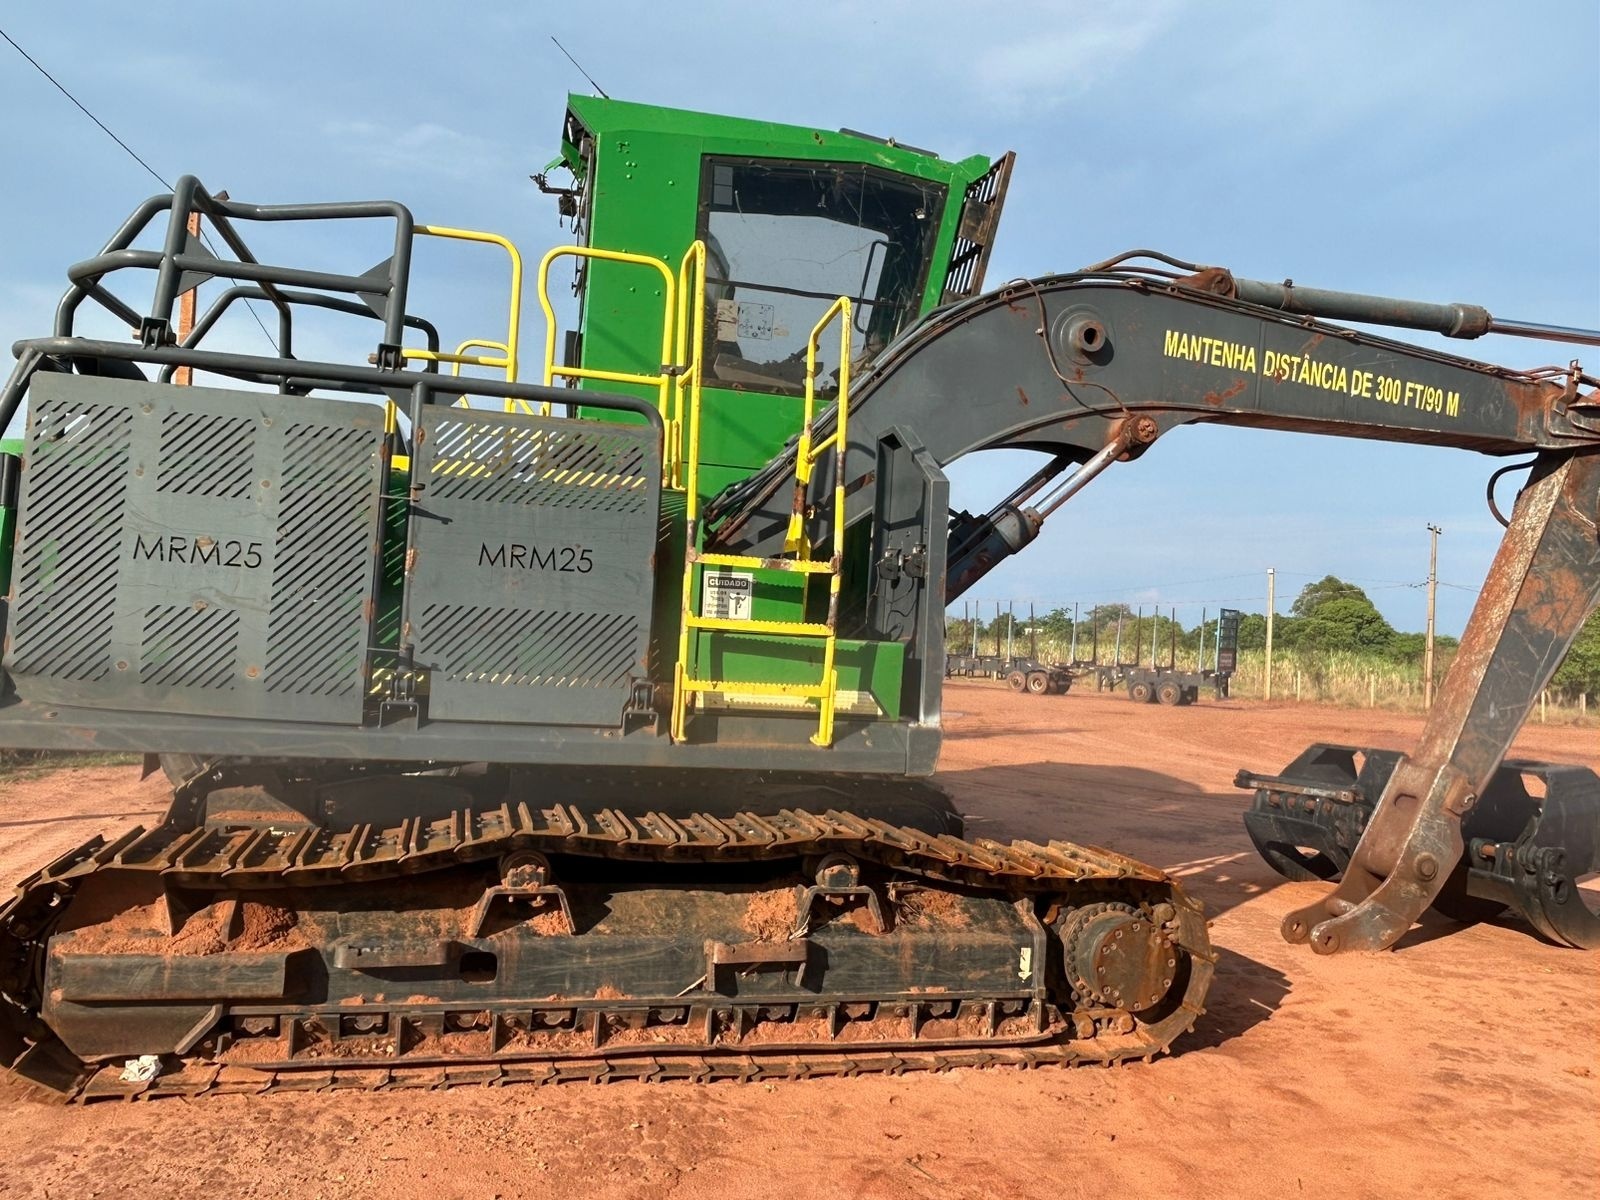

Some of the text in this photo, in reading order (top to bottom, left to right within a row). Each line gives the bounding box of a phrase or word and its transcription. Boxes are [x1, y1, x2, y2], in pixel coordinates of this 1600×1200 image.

[1164, 330, 1460, 417] MANTENHA DISTÂNCIA DE 300 FT/90 M
[133, 534, 262, 568] MRM25
[478, 542, 593, 573] MRM25
[709, 578, 747, 587] CUIDADO
